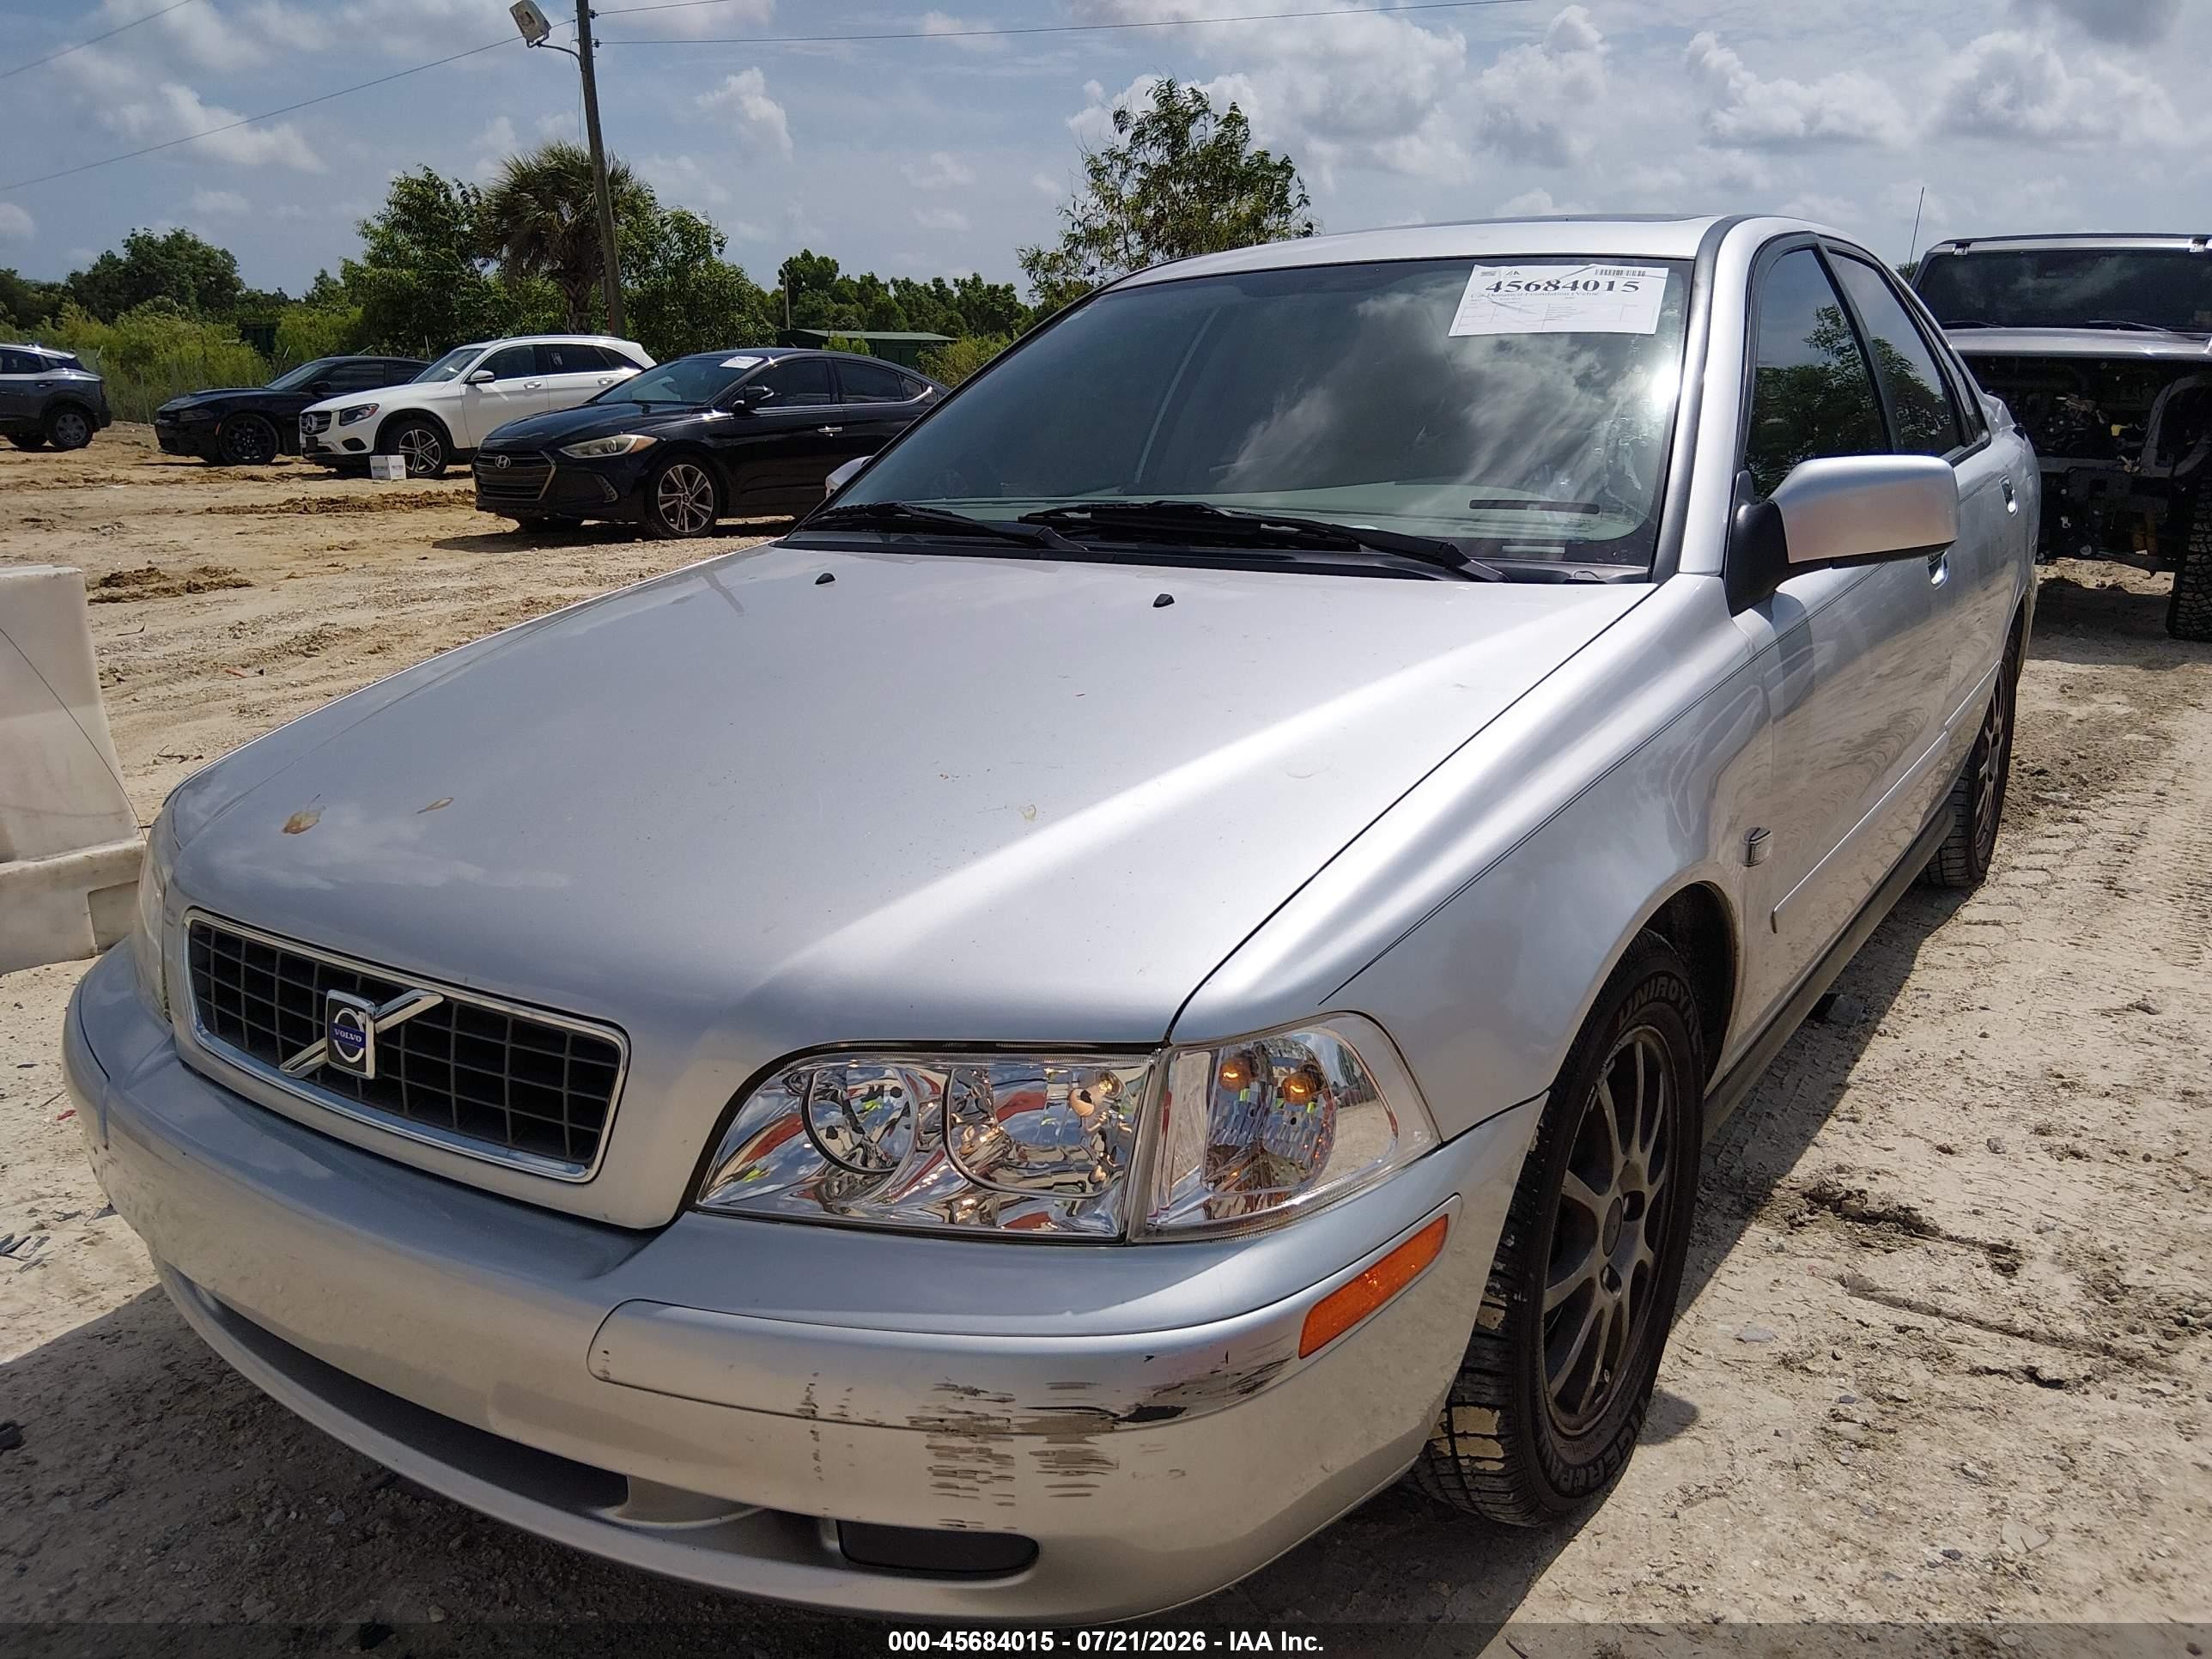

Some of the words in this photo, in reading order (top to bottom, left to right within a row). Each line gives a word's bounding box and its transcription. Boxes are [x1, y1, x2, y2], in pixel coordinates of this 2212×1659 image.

[1486, 279, 1639, 293] 45684015
[1617, 976, 1699, 1055] UNIROYAL
[334, 1028, 362, 1042] VOLVO
